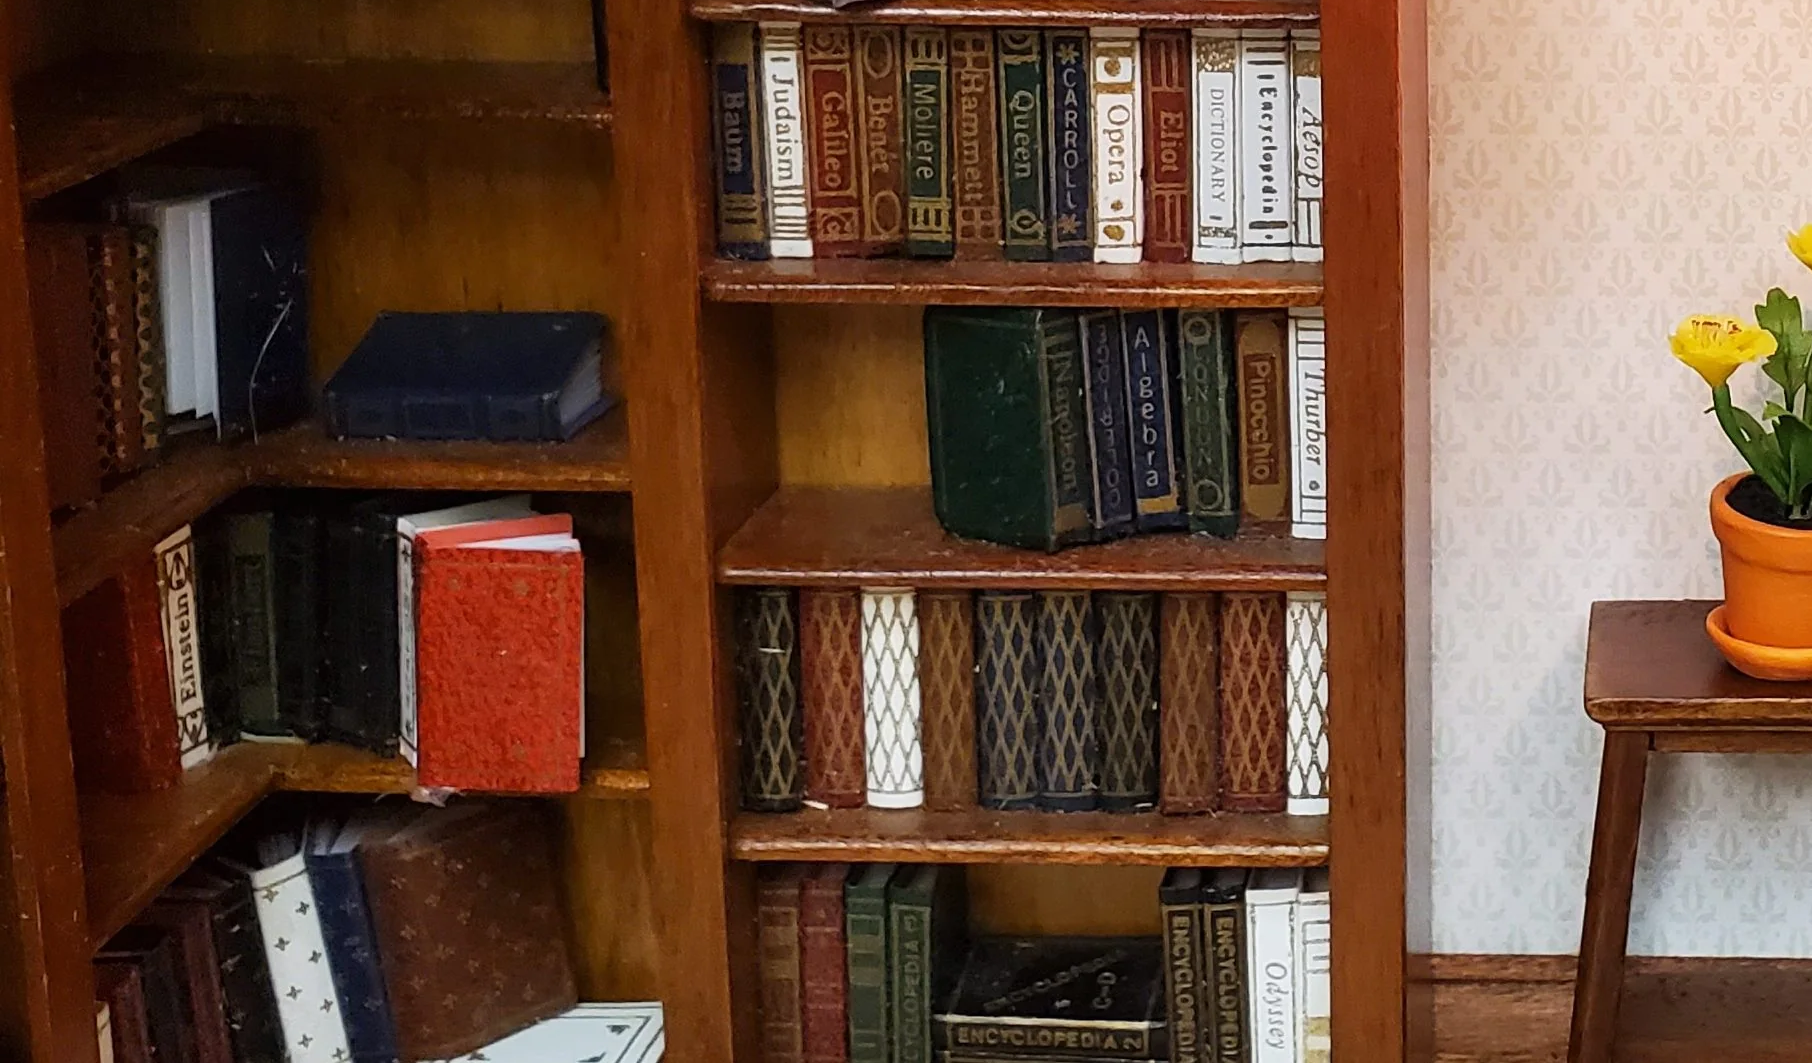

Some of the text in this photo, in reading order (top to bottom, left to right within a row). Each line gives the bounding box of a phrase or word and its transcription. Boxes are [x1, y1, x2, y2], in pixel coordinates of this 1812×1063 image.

[722, 91, 742, 174] Baum
[772, 74, 798, 181] Judaism
[821, 91, 848, 187] Galileo
[959, 72, 985, 202] Hammett
[1009, 90, 1035, 178] Queen
[1062, 69, 1080, 209] CARROLL
[1107, 104, 1130, 185] Opera
[1160, 110, 1184, 173] Eliot
[1209, 88, 1226, 203] DICTIONARY
[1298, 107, 1323, 188] Aesop
[1134, 326, 1160, 487] Algebra
[1249, 360, 1273, 480] Pinocchio
[1304, 368, 1326, 466] Thurber
[175, 593, 197, 704] Einstein
[958, 1027, 1117, 1050] ENCYCLOPEDIA
[1263, 962, 1289, 1049] Odyssey
